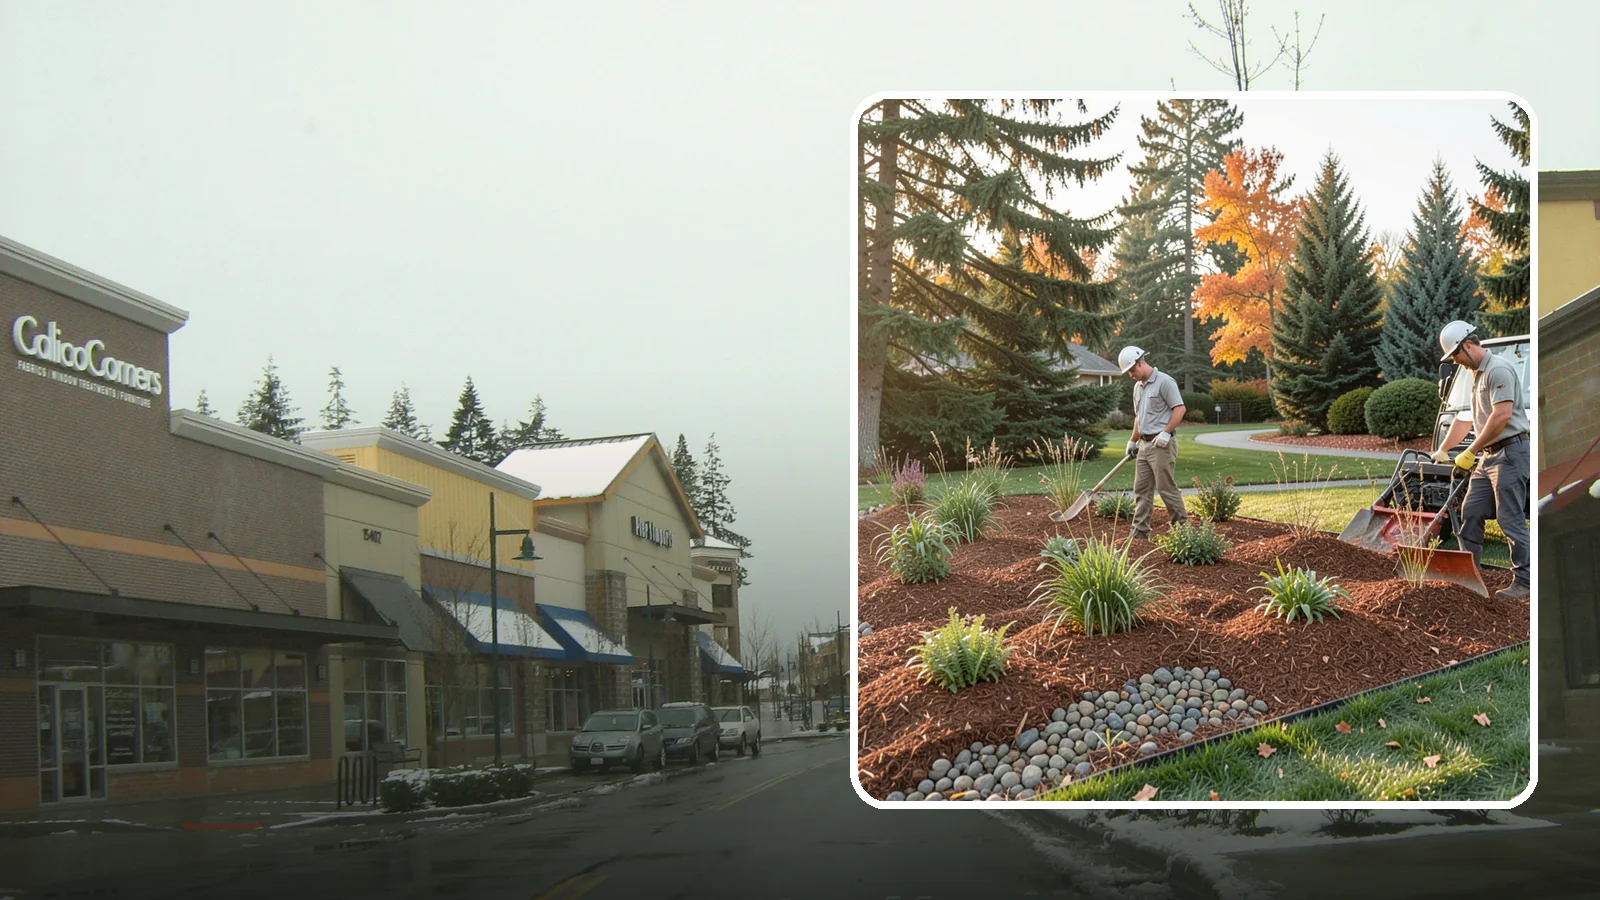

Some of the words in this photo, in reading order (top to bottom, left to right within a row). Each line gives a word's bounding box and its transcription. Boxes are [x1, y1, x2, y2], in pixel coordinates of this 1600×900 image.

[16, 360, 46, 377] FABRICS
[50, 369, 78, 387] WINDOW
[78, 378, 116, 399] TREATMENTS
[120, 391, 151, 409] FURNITURE
